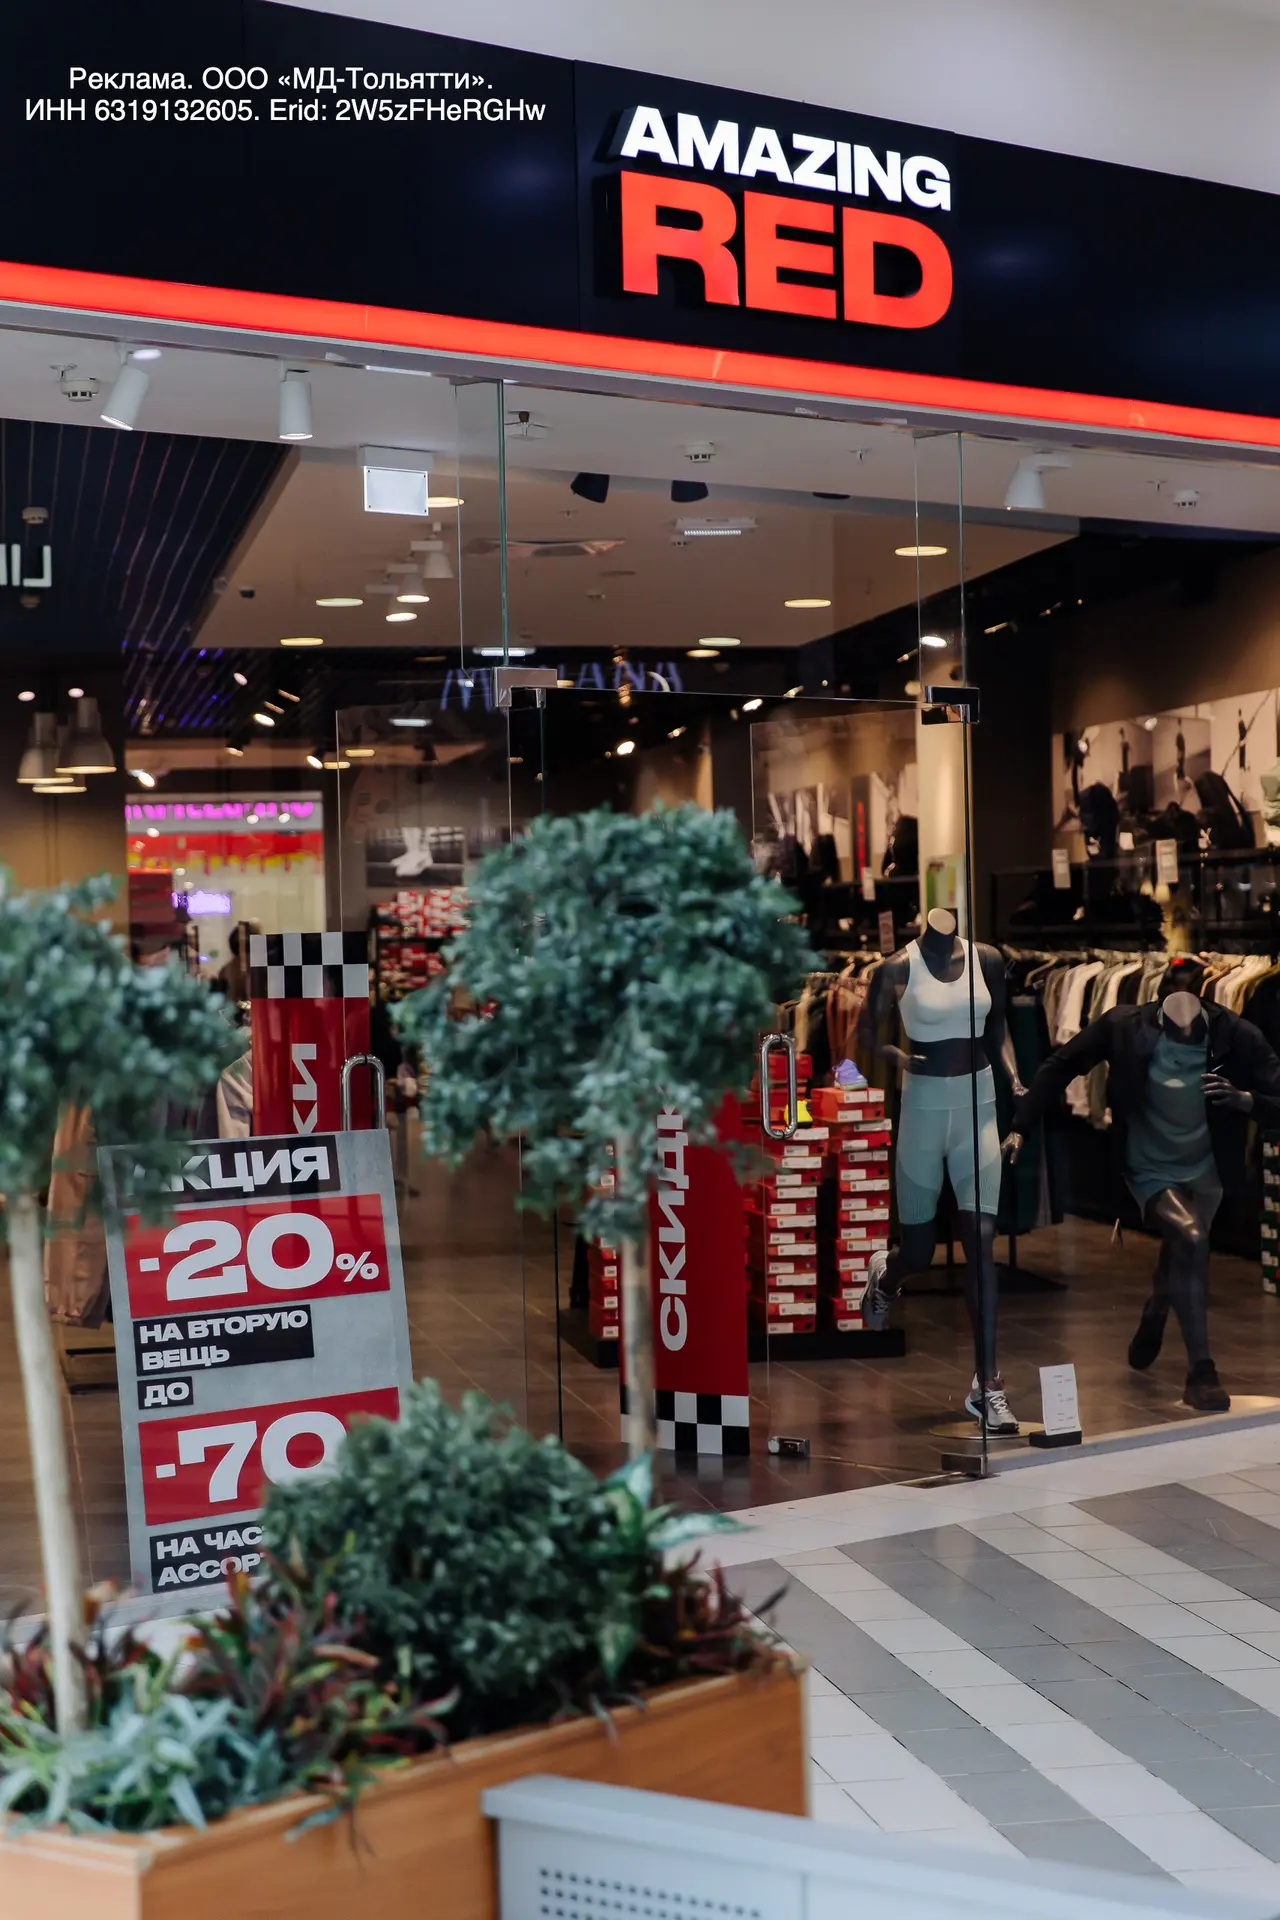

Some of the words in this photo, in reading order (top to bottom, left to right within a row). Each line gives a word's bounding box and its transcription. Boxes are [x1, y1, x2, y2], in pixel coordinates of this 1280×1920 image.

[620, 105, 951, 211] AMAZING
[620, 170, 953, 330] RED
[130, 1146, 331, 1194] КЦИЯ
[138, 1212, 380, 1302] -20%
[139, 1323, 184, 1344] НА
[188, 1309, 309, 1340] ВТОРУЮ
[141, 1345, 230, 1371] ВЕЩЬ
[143, 1381, 190, 1407] ДО
[155, 1536, 201, 1560] НА
[203, 1526, 265, 1551] ЧАС
[157, 1552, 265, 1587] АССОР
